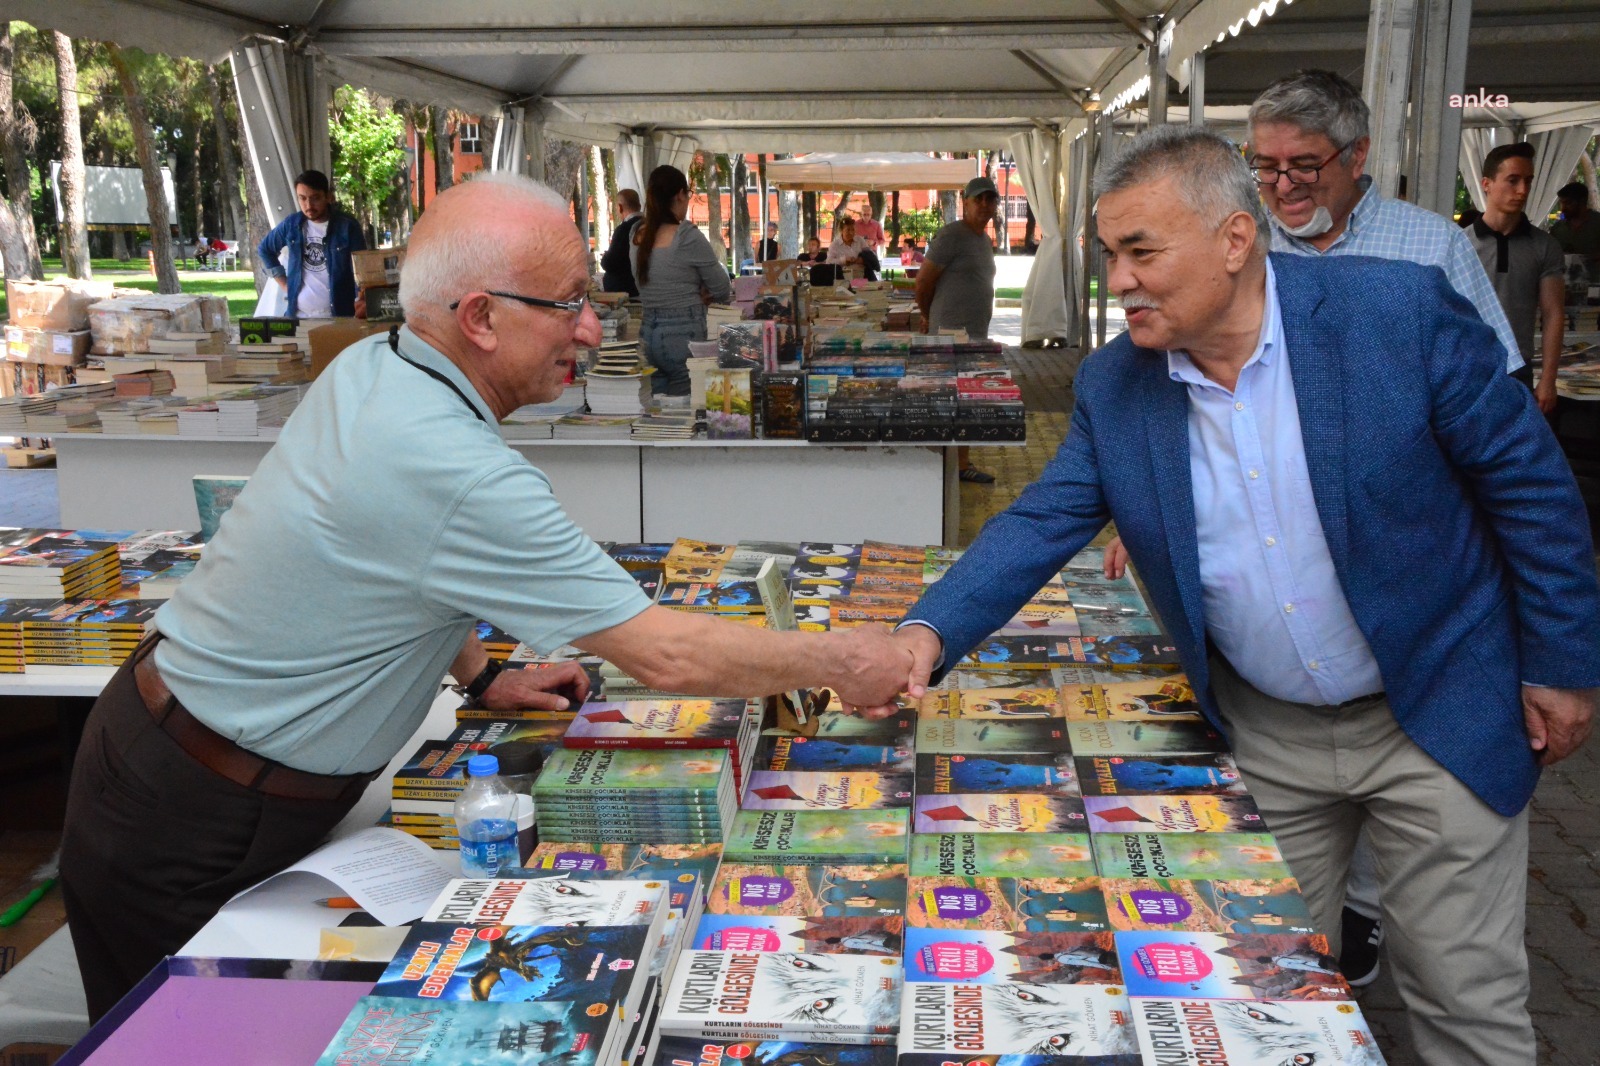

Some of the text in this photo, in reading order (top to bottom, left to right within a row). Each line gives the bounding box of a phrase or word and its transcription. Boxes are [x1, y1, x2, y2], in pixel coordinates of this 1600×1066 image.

[770, 736, 793, 771] HAYALET
[934, 755, 954, 793] HAYALET
[1093, 757, 1118, 794] HAYALET
[752, 812, 778, 850] KİMSESİZ
[777, 812, 796, 850] ÇOCUKLAR
[936, 834, 956, 876] KİMSESİZ
[962, 834, 980, 876] ÇOCUKLAR
[1120, 834, 1149, 878] KİMSESİZ
[1145, 834, 1174, 878] ÇOCUKLAR
[436, 881, 493, 923] RTLARIN
[474, 880, 527, 926] LGESİNDE
[742, 883, 767, 898] DÜŞ
[938, 894, 962, 910] DÜŞ
[963, 893, 977, 911] KALESİ
[1138, 898, 1162, 914] DÜŞ
[1162, 898, 1179, 915] KALESİ
[725, 931, 751, 951] ERİLİ
[752, 933, 768, 951] CALAR
[938, 946, 962, 973] PERİLİ
[401, 941, 442, 983] UZAYLI
[418, 927, 477, 999] EJDERHALAR
[1152, 948, 1181, 976] PERİLİ
[677, 952, 725, 1015] KURTLARIN
[711, 953, 761, 1015] GÖLGESİNDE
[853, 965, 866, 1006] NİHAT GÖKMEN
[333, 1006, 395, 1066] ENİZDE
[702, 1030, 780, 1040] KURTLARIN GÖLGESİNDE
[743, 1021, 783, 1029] GÖLGESİNDE
[833, 1022, 860, 1031] GÖKMEN
[913, 984, 946, 1050] KURTLARIN
[947, 985, 985, 1051] GÖLGESİNDE
[1084, 997, 1099, 1042] NİHAT GÖKMEN
[1141, 1001, 1188, 1066] KURTLARIN
[1180, 1001, 1228, 1066] GÖLGESİNDE
[1316, 1016, 1336, 1044] GÖKMEN
[382, 1009, 441, 1066] RTINA
[810, 1034, 857, 1043] NİHAT GÖKMEN
